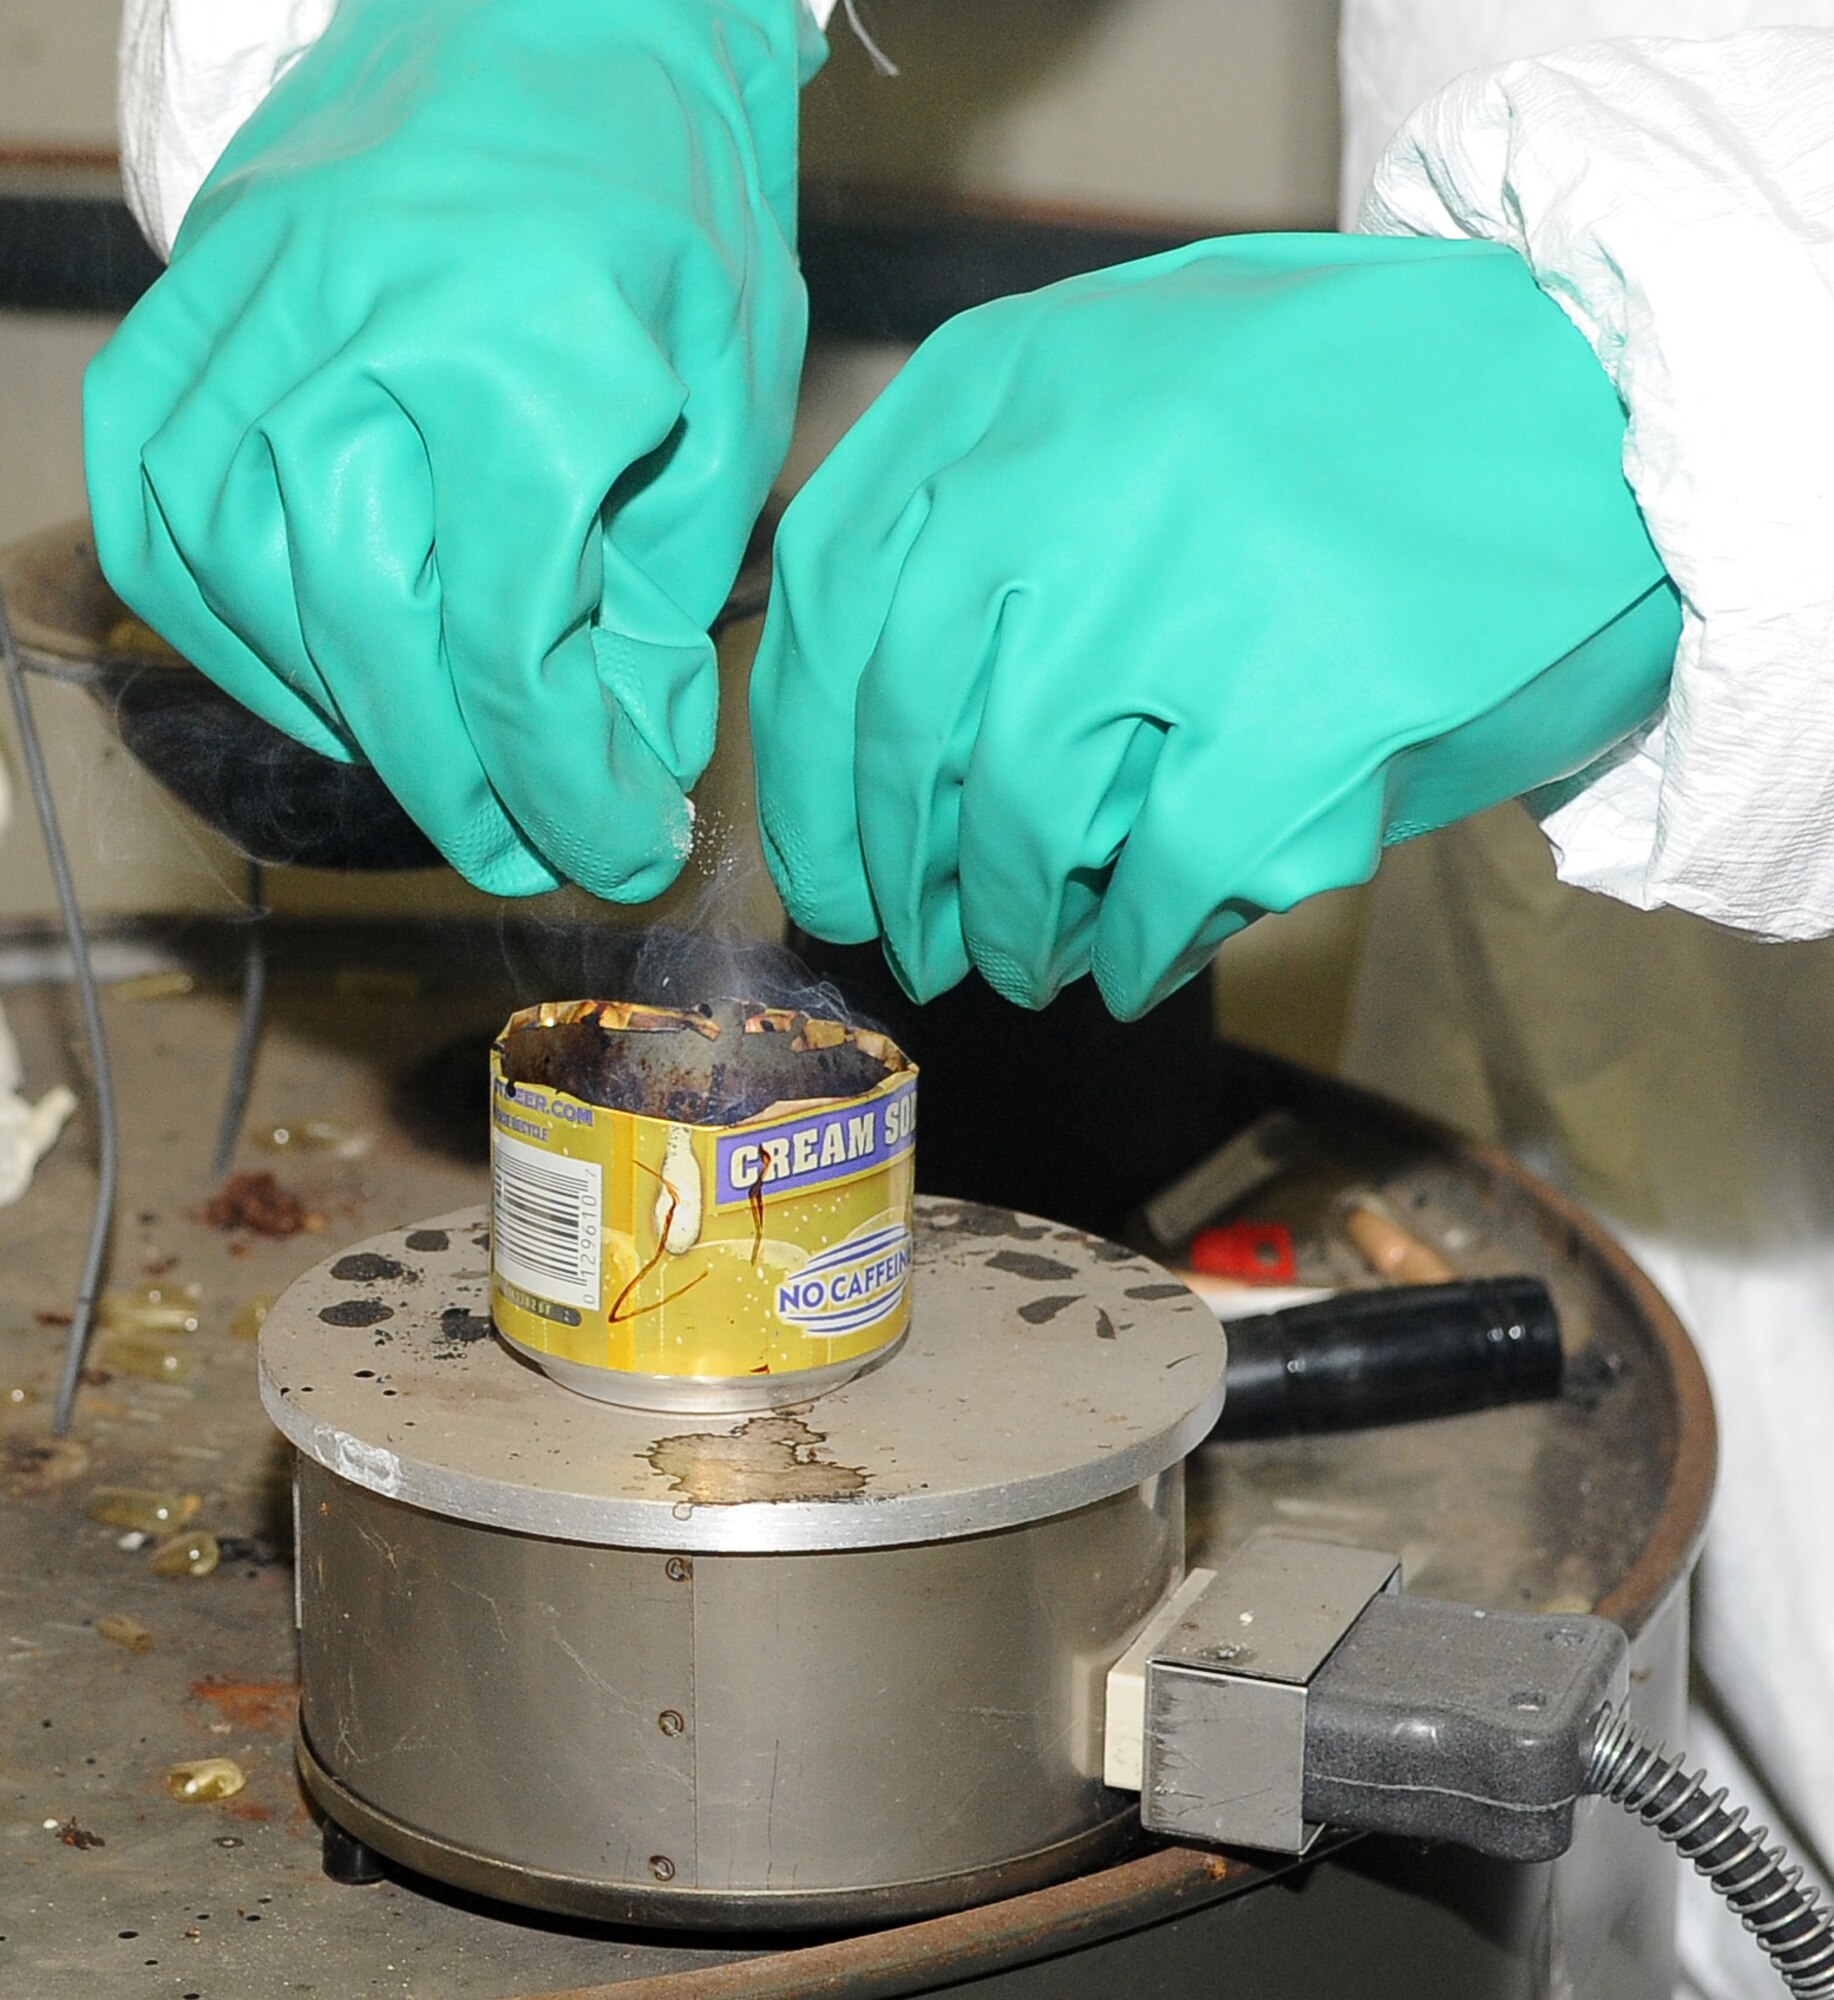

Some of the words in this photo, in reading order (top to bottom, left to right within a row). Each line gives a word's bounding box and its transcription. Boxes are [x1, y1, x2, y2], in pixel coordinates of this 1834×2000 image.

[729, 1111, 875, 1190] CREAM
[581, 1195, 597, 1277] 129610
[779, 1284, 825, 1313] NO
